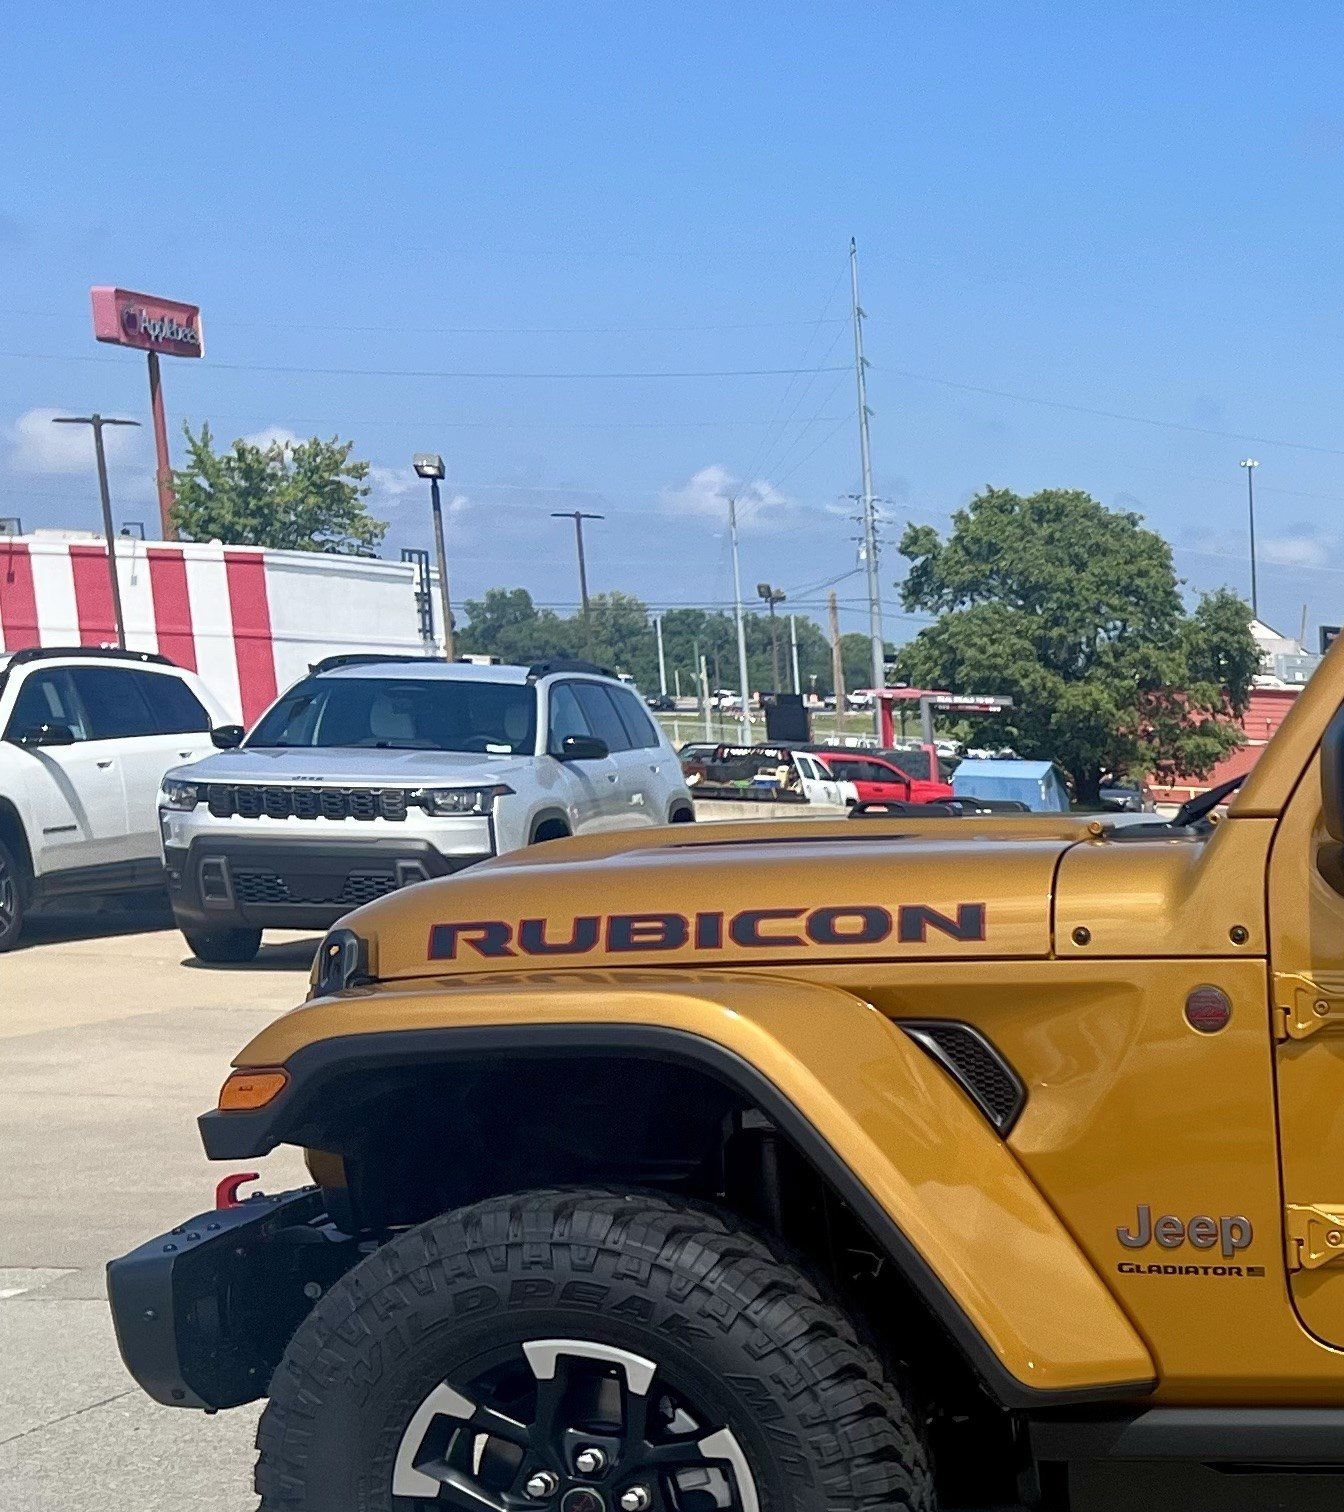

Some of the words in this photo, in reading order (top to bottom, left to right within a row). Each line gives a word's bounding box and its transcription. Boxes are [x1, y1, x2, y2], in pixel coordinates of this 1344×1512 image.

[426, 902, 986, 960] RUBICON
[1116, 1204, 1253, 1258] Jeep
[1117, 1262, 1244, 1278] GLADIATOR
[345, 1277, 716, 1404] WILDPEAK
